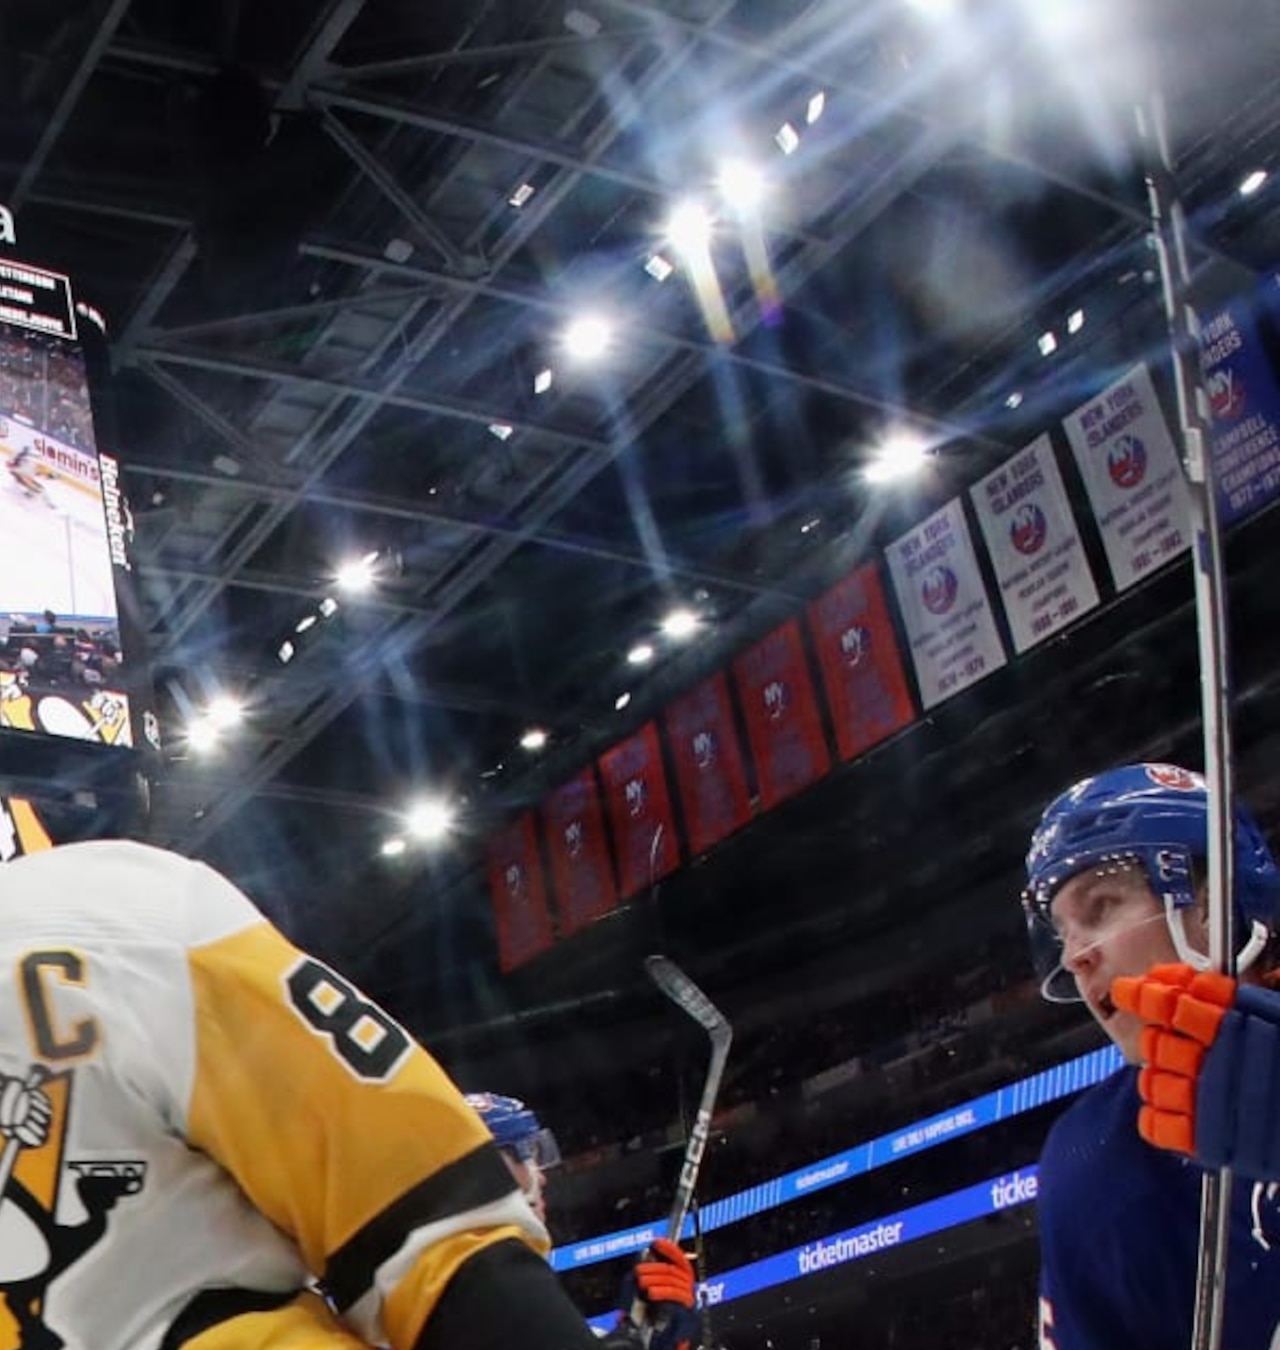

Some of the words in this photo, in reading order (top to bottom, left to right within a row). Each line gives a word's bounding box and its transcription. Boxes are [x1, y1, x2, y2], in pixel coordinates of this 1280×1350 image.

[13, 948, 101, 1062] C
[279, 954, 416, 1087] 8
[797, 1219, 904, 1275] ticketmaster
